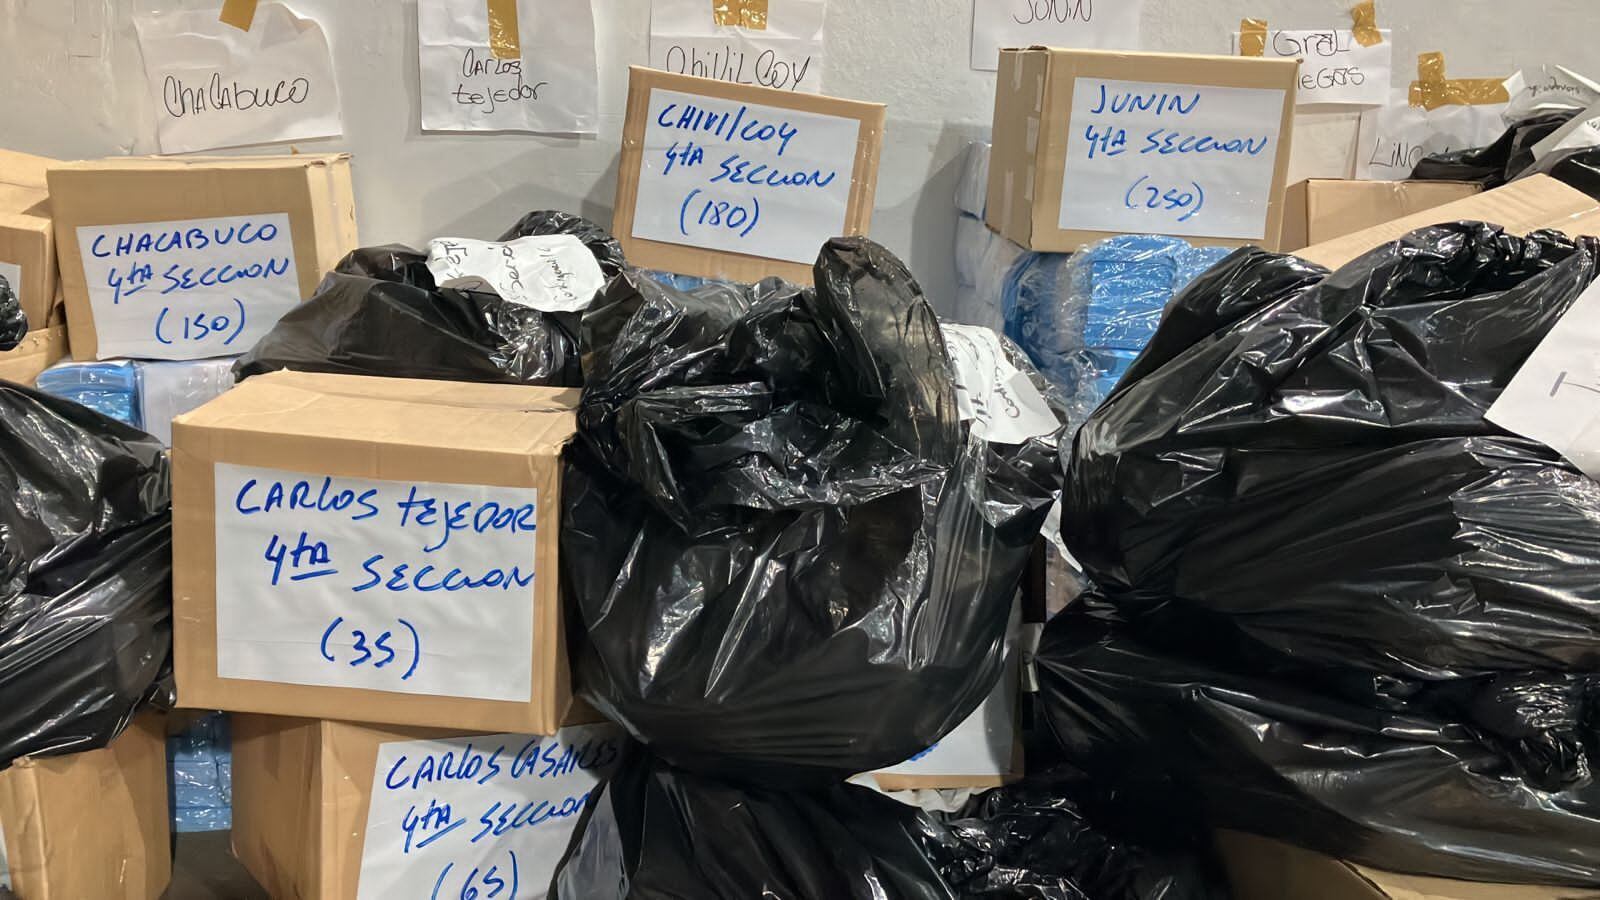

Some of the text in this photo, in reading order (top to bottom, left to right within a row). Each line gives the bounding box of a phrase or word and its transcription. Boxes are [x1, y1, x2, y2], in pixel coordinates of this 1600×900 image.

[452, 75, 548, 113] tejedor
[1091, 85, 1200, 115] JUNIN
[1140, 129, 1267, 155] SECCION
[710, 155, 835, 187] SECCION
[680, 188, 759, 237] (180)
[1124, 175, 1203, 222] (250)
[91, 223, 277, 257] CHACABUCO
[161, 258, 289, 294] SECCION
[155, 298, 245, 345] (150)
[236, 477, 378, 520] CARLOS
[352, 554, 535, 591] SECCION
[320, 616, 420, 680] (35)
[385, 743, 504, 790] CARLOS
[431, 850, 519, 900] (65)
